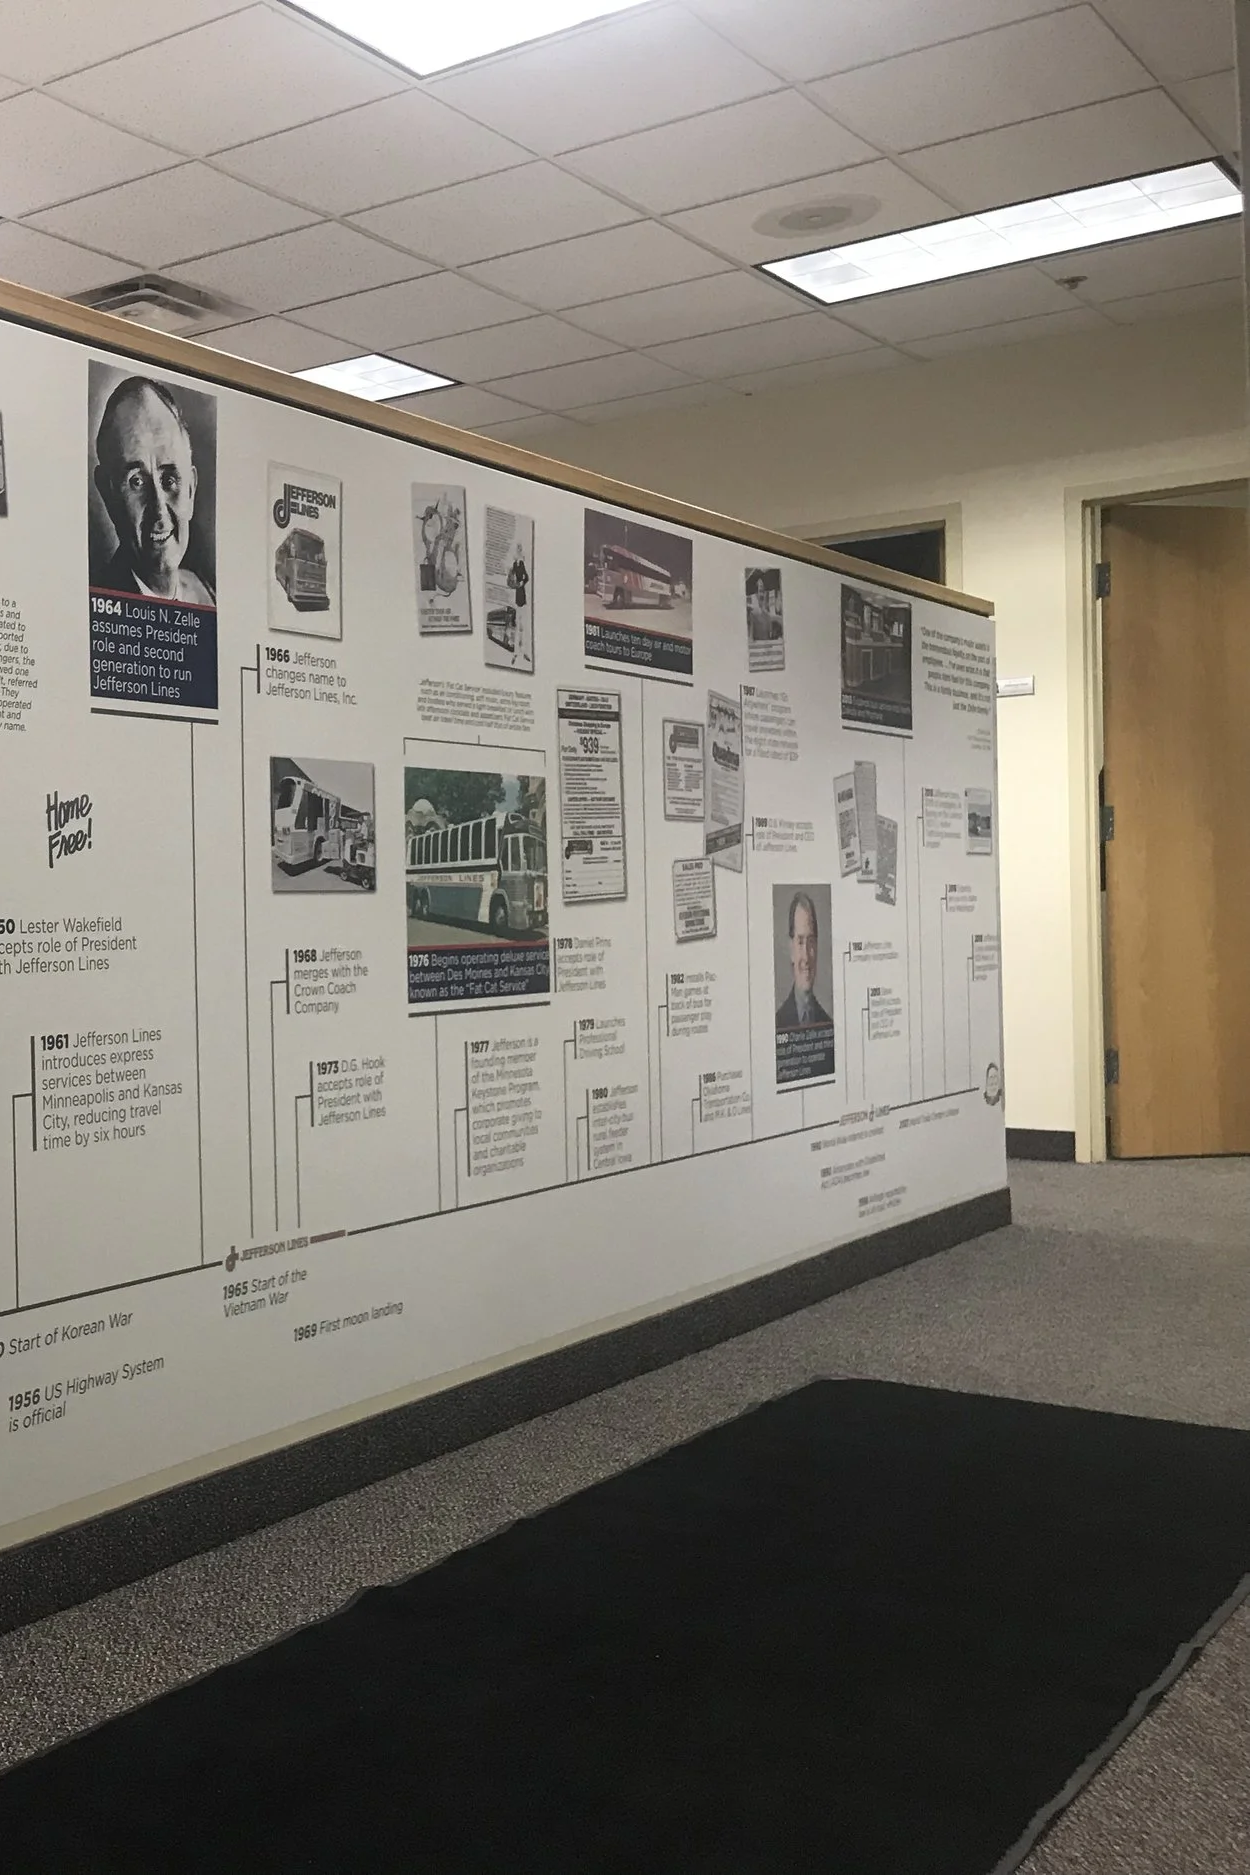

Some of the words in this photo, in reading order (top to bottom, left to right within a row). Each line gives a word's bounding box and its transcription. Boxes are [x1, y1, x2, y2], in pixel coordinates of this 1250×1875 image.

[91, 598, 122, 616] 1964
[126, 603, 156, 622] Louis
[160, 608, 170, 624] N.
[175, 611, 200, 628] Zelle
[92, 622, 142, 639] assumes
[146, 626, 197, 646] President
[93, 638, 115, 653] role
[119, 642, 140, 656] and
[144, 647, 184, 662] second
[267, 647, 290, 663] 1966
[293, 651, 336, 669] Jefferson
[93, 659, 155, 677] generation
[160, 665, 170, 679] to
[174, 670, 192, 682] run
[266, 667, 306, 684] changes
[309, 674, 334, 686] name
[337, 675, 346, 688] to
[94, 676, 147, 695] Jefferson
[152, 682, 180, 698] Lines
[266, 684, 311, 700] Jefferson
[46, 790, 92, 832] Home
[48, 817, 92, 869] Free!
[20, 918, 58, 934] Lester
[64, 917, 122, 933] Wakefield
[38, 938, 61, 954] role
[65, 938, 76, 953] of
[82, 936, 136, 952] President
[294, 949, 317, 963] 1968
[319, 948, 362, 962] Jefferson
[16, 958, 74, 974] Jefferson
[79, 957, 109, 972] Lines
[408, 954, 429, 967] 1976
[294, 970, 329, 982] merges
[331, 966, 351, 978] with
[353, 965, 368, 977] the
[294, 985, 325, 997] Crown
[327, 982, 356, 995] Coach
[294, 1002, 339, 1014] Company
[41, 1033, 69, 1051] 1961
[73, 1032, 128, 1048] Jefferson
[132, 1029, 161, 1044] Lines
[470, 1040, 489, 1053] 1977
[42, 1053, 106, 1071] introduces
[110, 1050, 153, 1067] express
[316, 1061, 339, 1075] 1973
[362, 1057, 385, 1070] Hook
[42, 1073, 91, 1090] services
[96, 1069, 146, 1085] between
[316, 1077, 353, 1092] accepts
[355, 1075, 372, 1088] role
[374, 1073, 383, 1086] of
[316, 1092, 361, 1109] President
[363, 1090, 382, 1103] with
[318, 1112, 360, 1126] Jefferson
[223, 1280, 248, 1300] 1965
[251, 1274, 275, 1293] Start
[278, 1272, 288, 1287] of
[291, 1269, 307, 1284] the
[224, 1299, 266, 1318] Vietnam
[269, 1292, 287, 1307] War
[294, 1322, 317, 1342] 1969
[319, 1317, 340, 1335] First
[342, 1313, 369, 1329] moon
[371, 1304, 403, 1322] landing
[8, 1332, 40, 1355] Start
[44, 1329, 56, 1347] of
[61, 1322, 104, 1343] Korean
[110, 1314, 133, 1331] War
[9, 1387, 40, 1411] 1956
[44, 1381, 62, 1401] US
[66, 1371, 118, 1396] Highway
[122, 1359, 164, 1382] System
[8, 1416, 18, 1433] is
[22, 1403, 65, 1429] official
